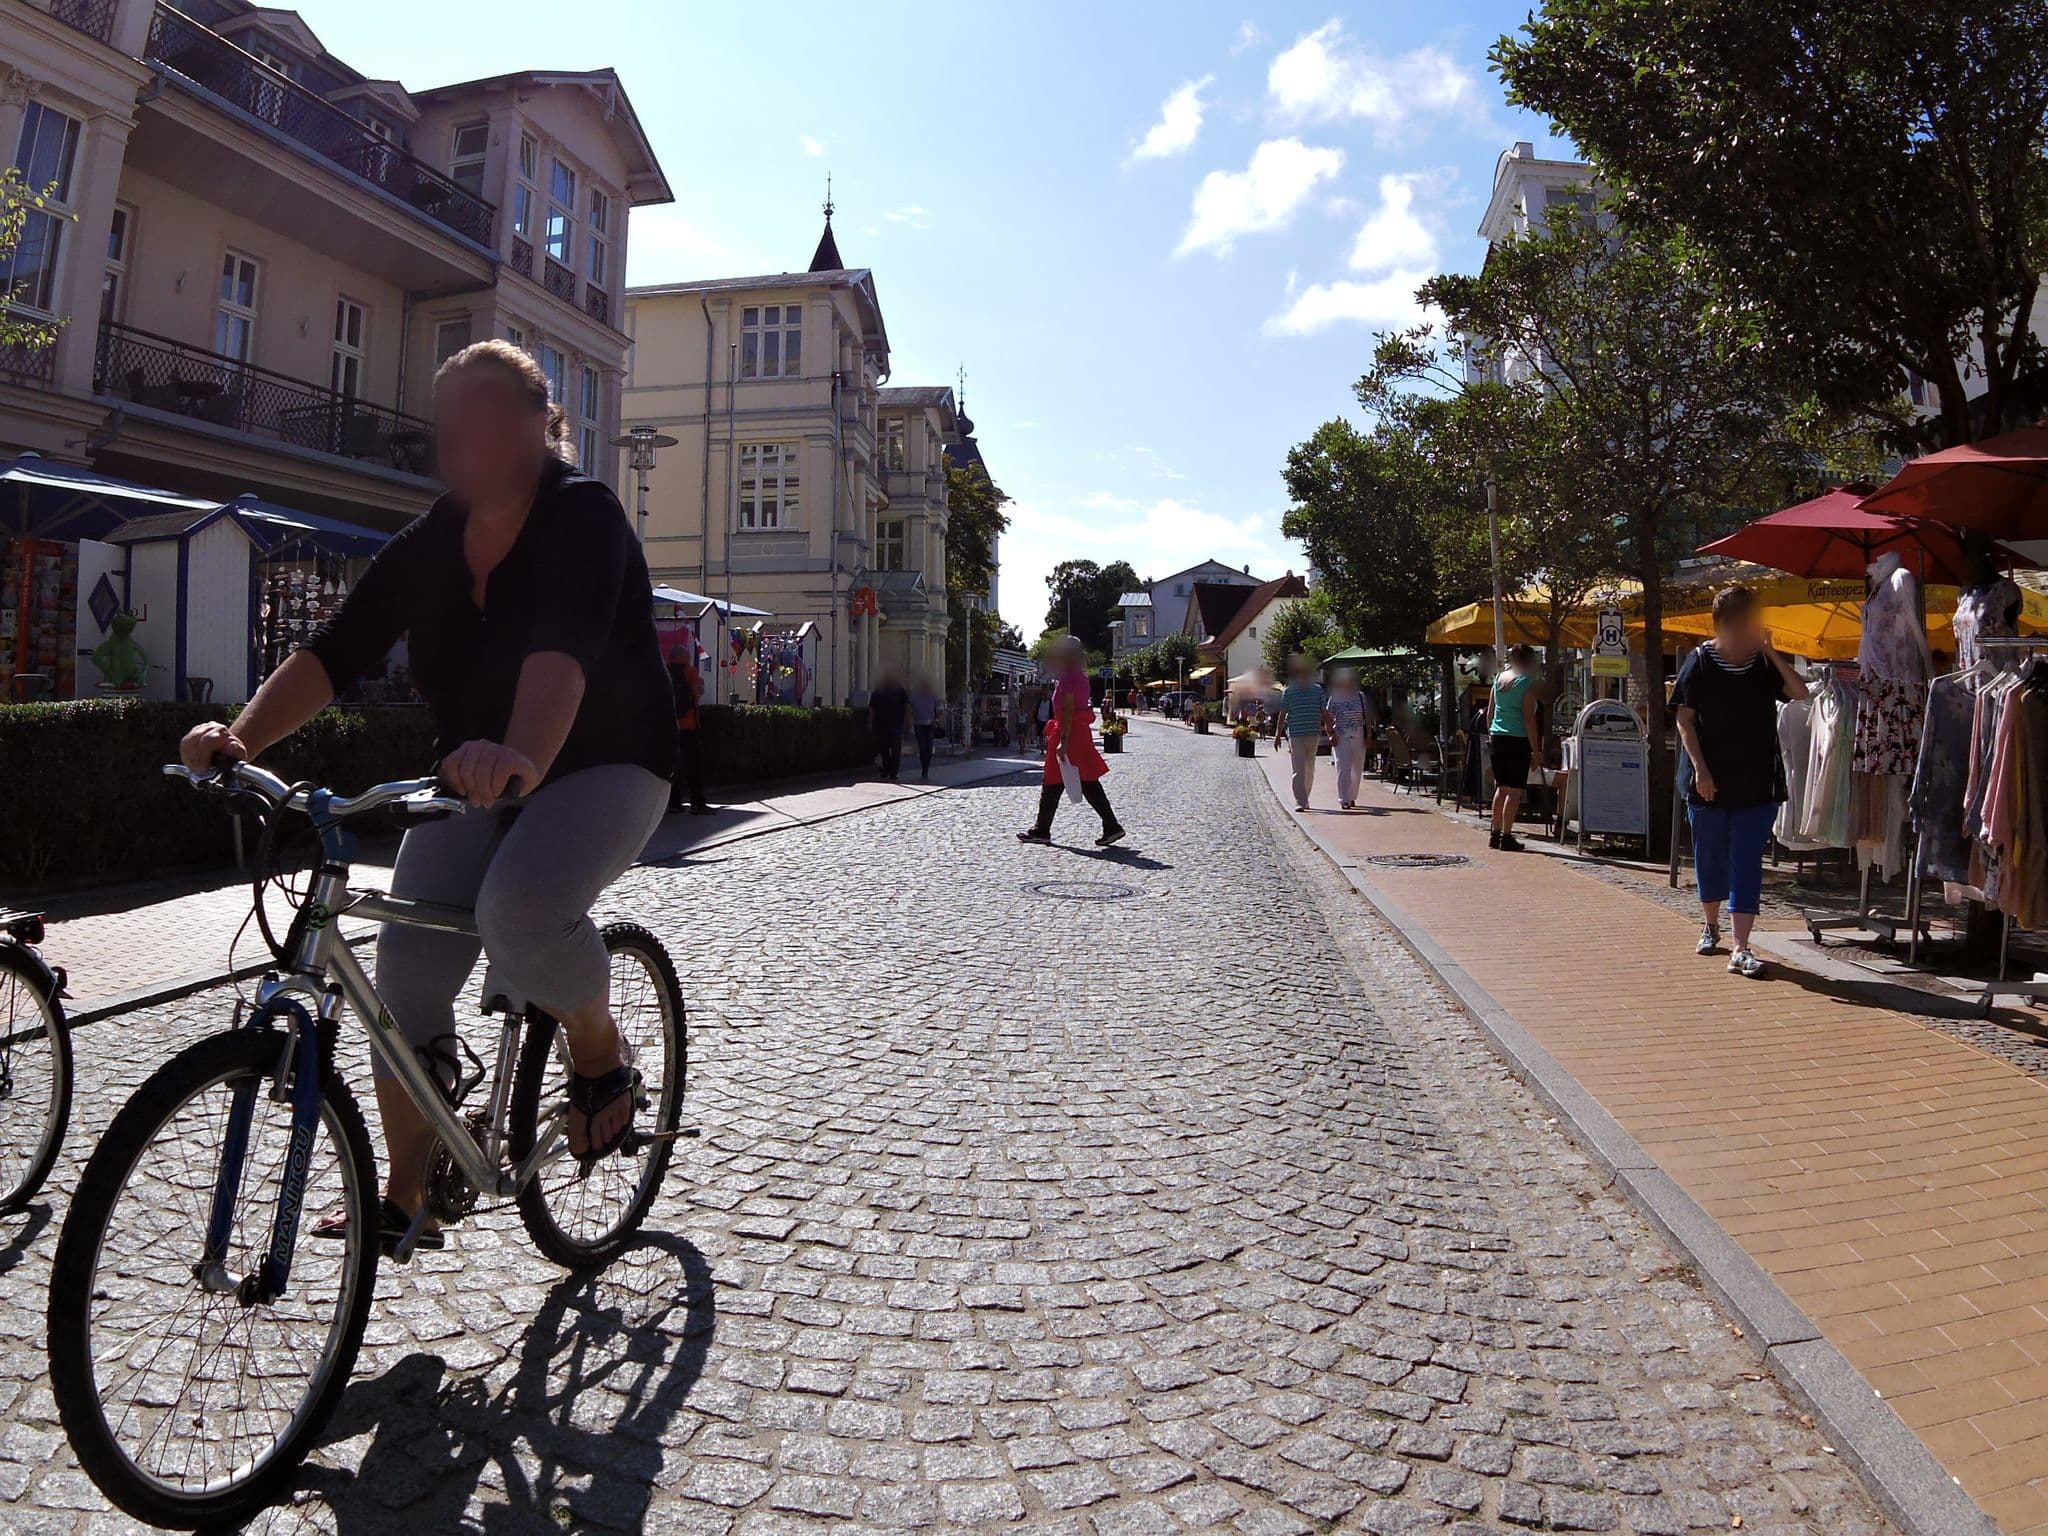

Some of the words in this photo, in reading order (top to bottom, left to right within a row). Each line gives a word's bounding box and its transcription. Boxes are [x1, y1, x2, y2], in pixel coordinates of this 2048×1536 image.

[1808, 582, 1865, 599] Kaffeespez
[1606, 630, 1617, 642] H
[274, 1126, 311, 1265] MANITOU
